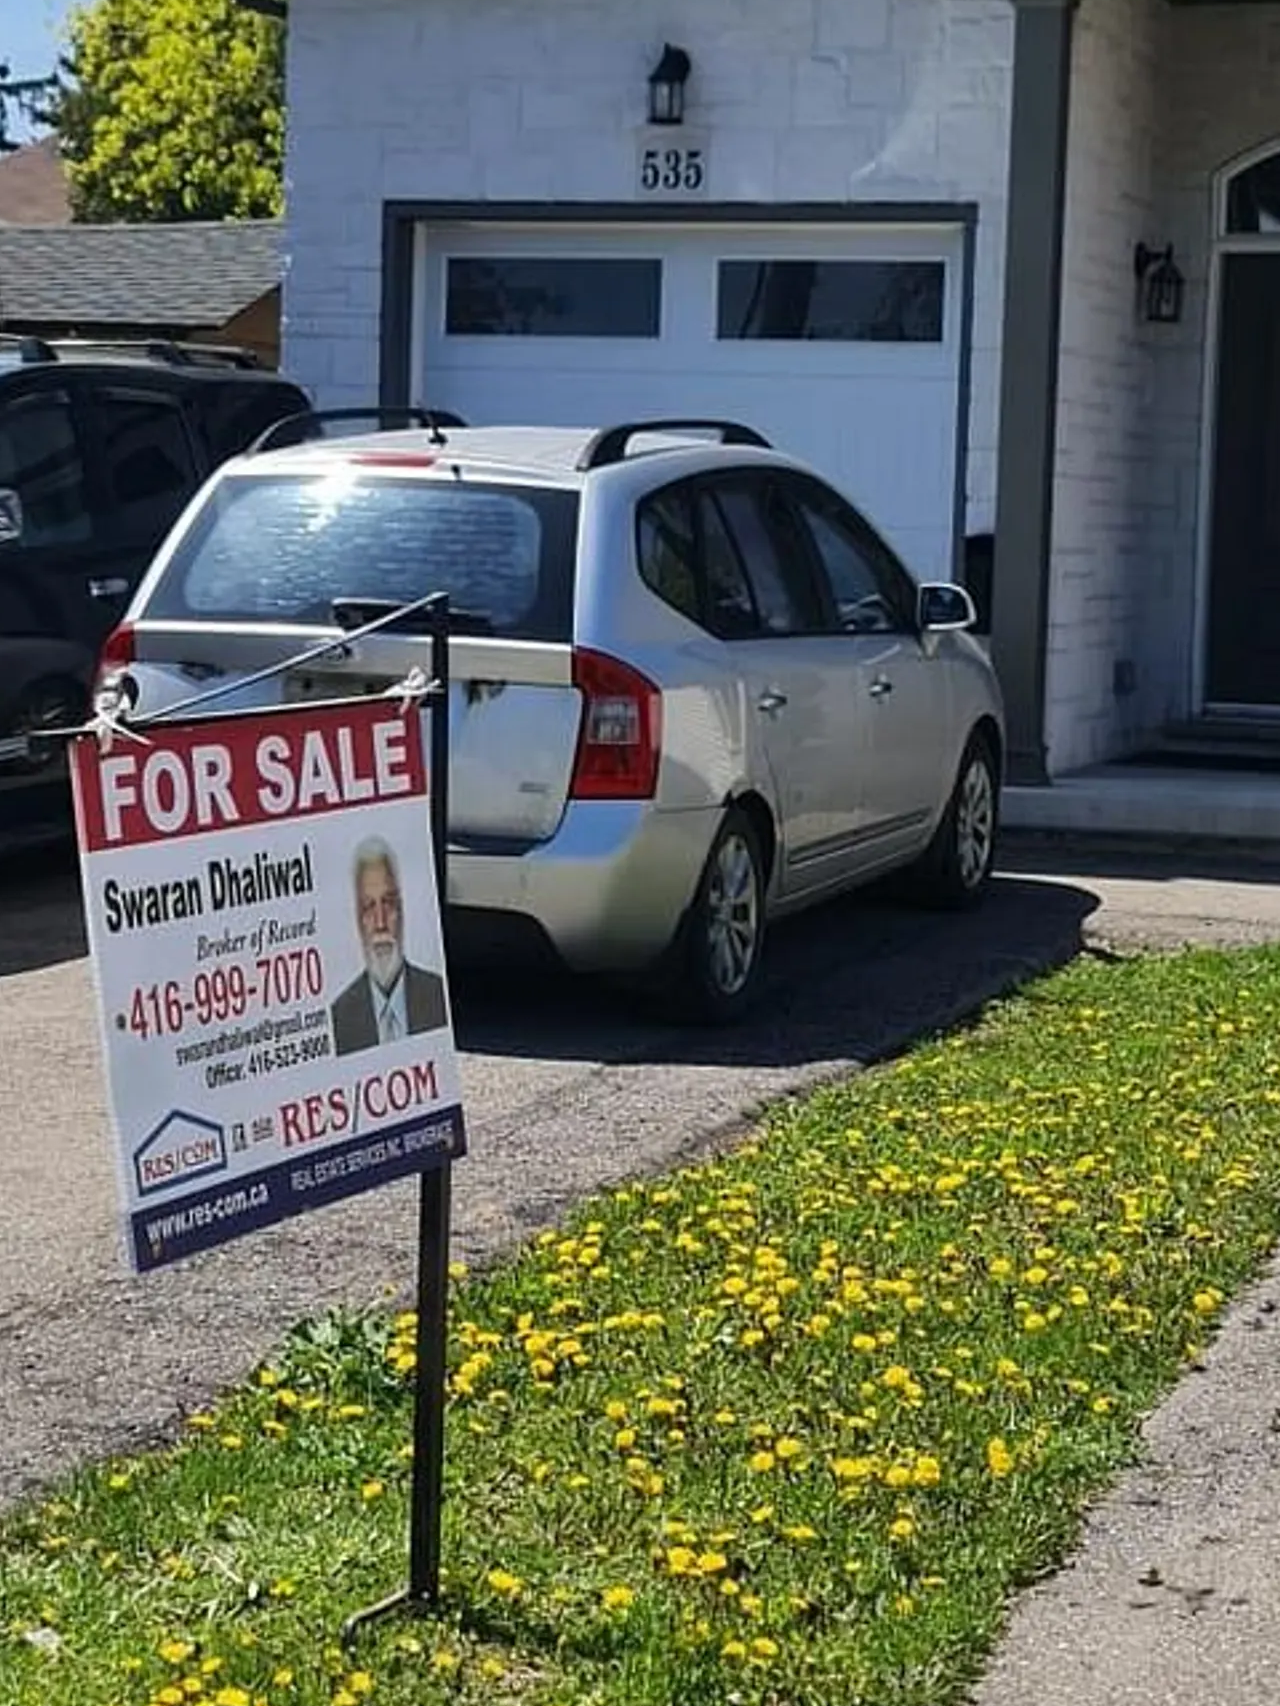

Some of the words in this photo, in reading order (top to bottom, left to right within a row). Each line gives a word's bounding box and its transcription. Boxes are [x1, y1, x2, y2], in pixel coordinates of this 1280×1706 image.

[642, 149, 703, 190] 535
[99, 744, 241, 842] FOR
[255, 718, 412, 815] SALE
[104, 878, 204, 934] Swaran
[207, 842, 314, 912] Dhaliwal
[196, 926, 247, 961] Broker
[249, 917, 266, 957] of
[267, 906, 317, 946] Record
[130, 946, 323, 1041] 416-999-7070
[279, 1060, 439, 1147] RES/COM
[143, 1137, 219, 1182] RES/COM
[145, 1182, 269, 1244] www.res-com.ca
